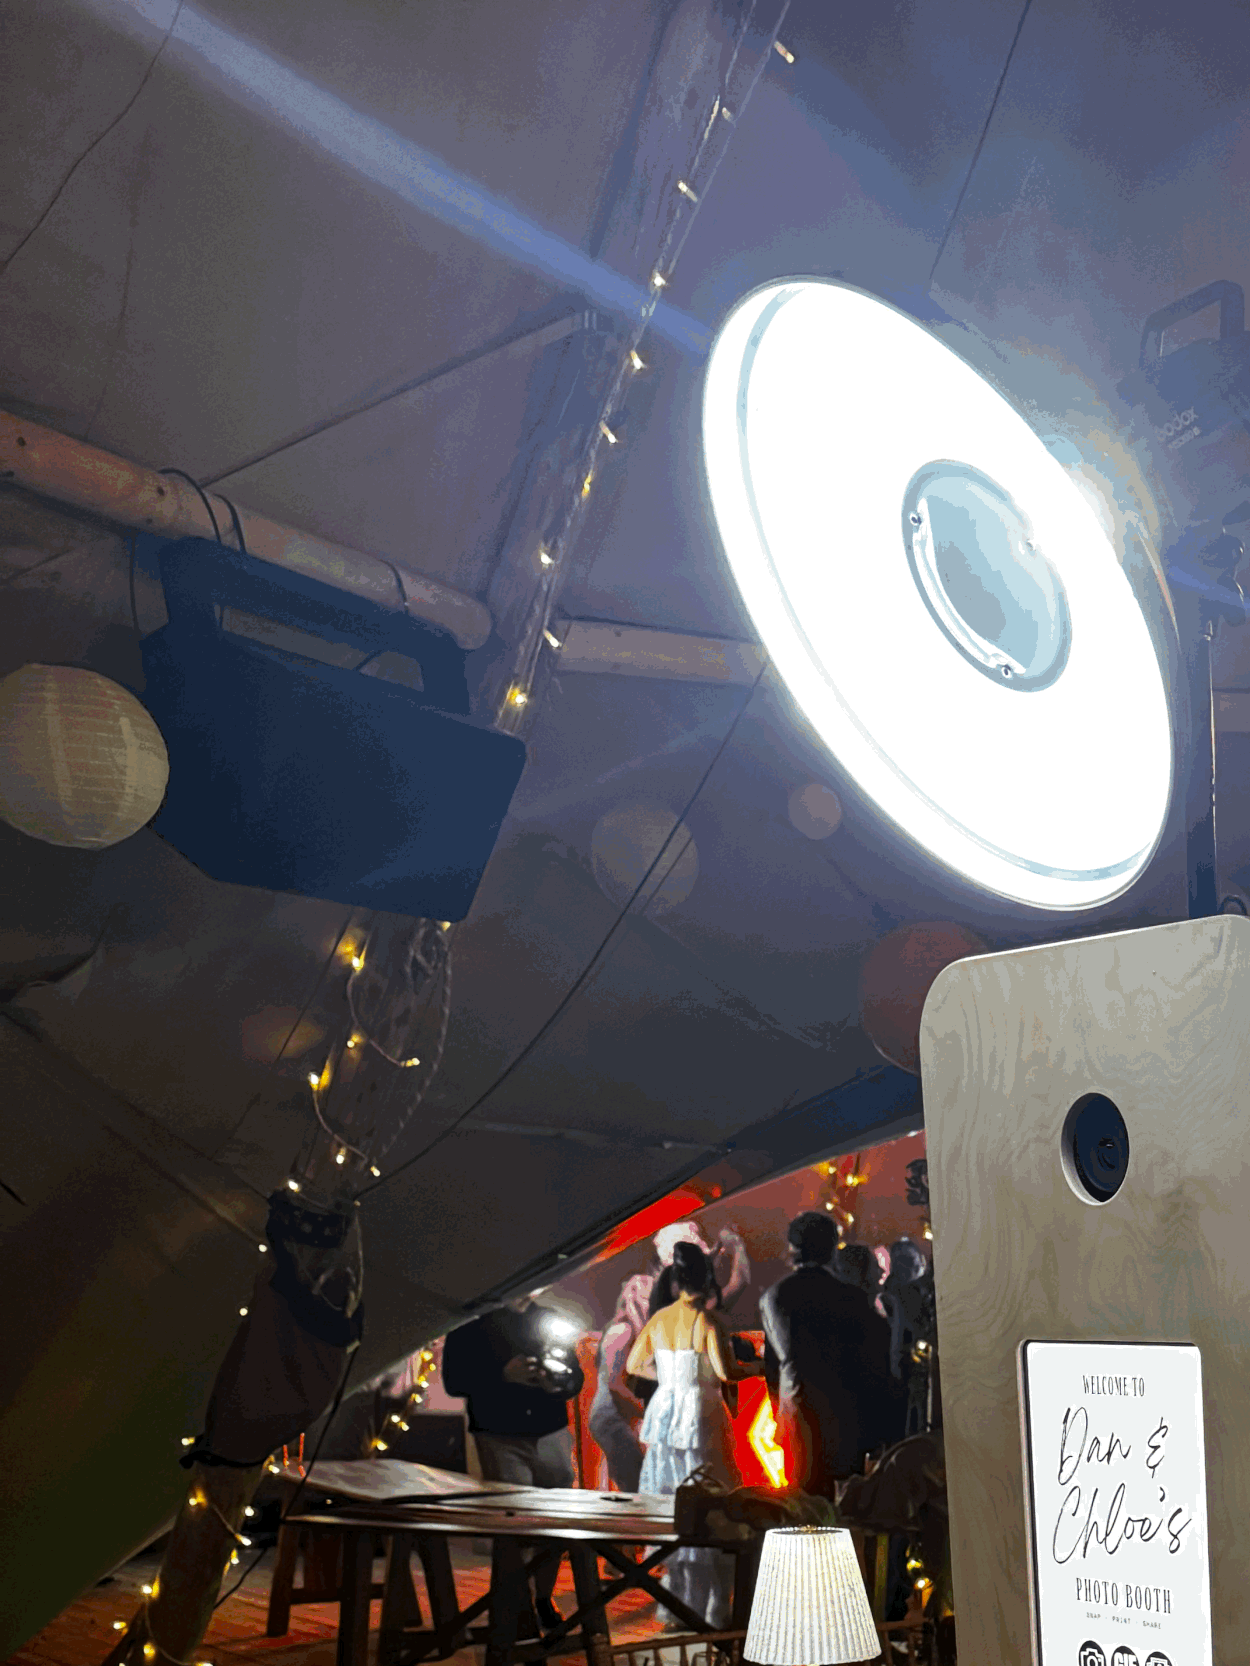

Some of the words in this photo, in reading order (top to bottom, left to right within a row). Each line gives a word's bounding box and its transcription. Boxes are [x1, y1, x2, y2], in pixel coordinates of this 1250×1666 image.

[1082, 1374, 1129, 1397] WELCOME
[1130, 1376, 1146, 1398] TO
[1057, 1406, 1132, 1486] Dan
[1145, 1416, 1169, 1480] &
[1052, 1482, 1192, 1565] Chloe's
[1075, 1576, 1119, 1607] PHOTO
[1125, 1583, 1172, 1614] BOOTH
[1111, 1615, 1131, 1625] PRINT
[1142, 1620, 1162, 1630] SHARE
